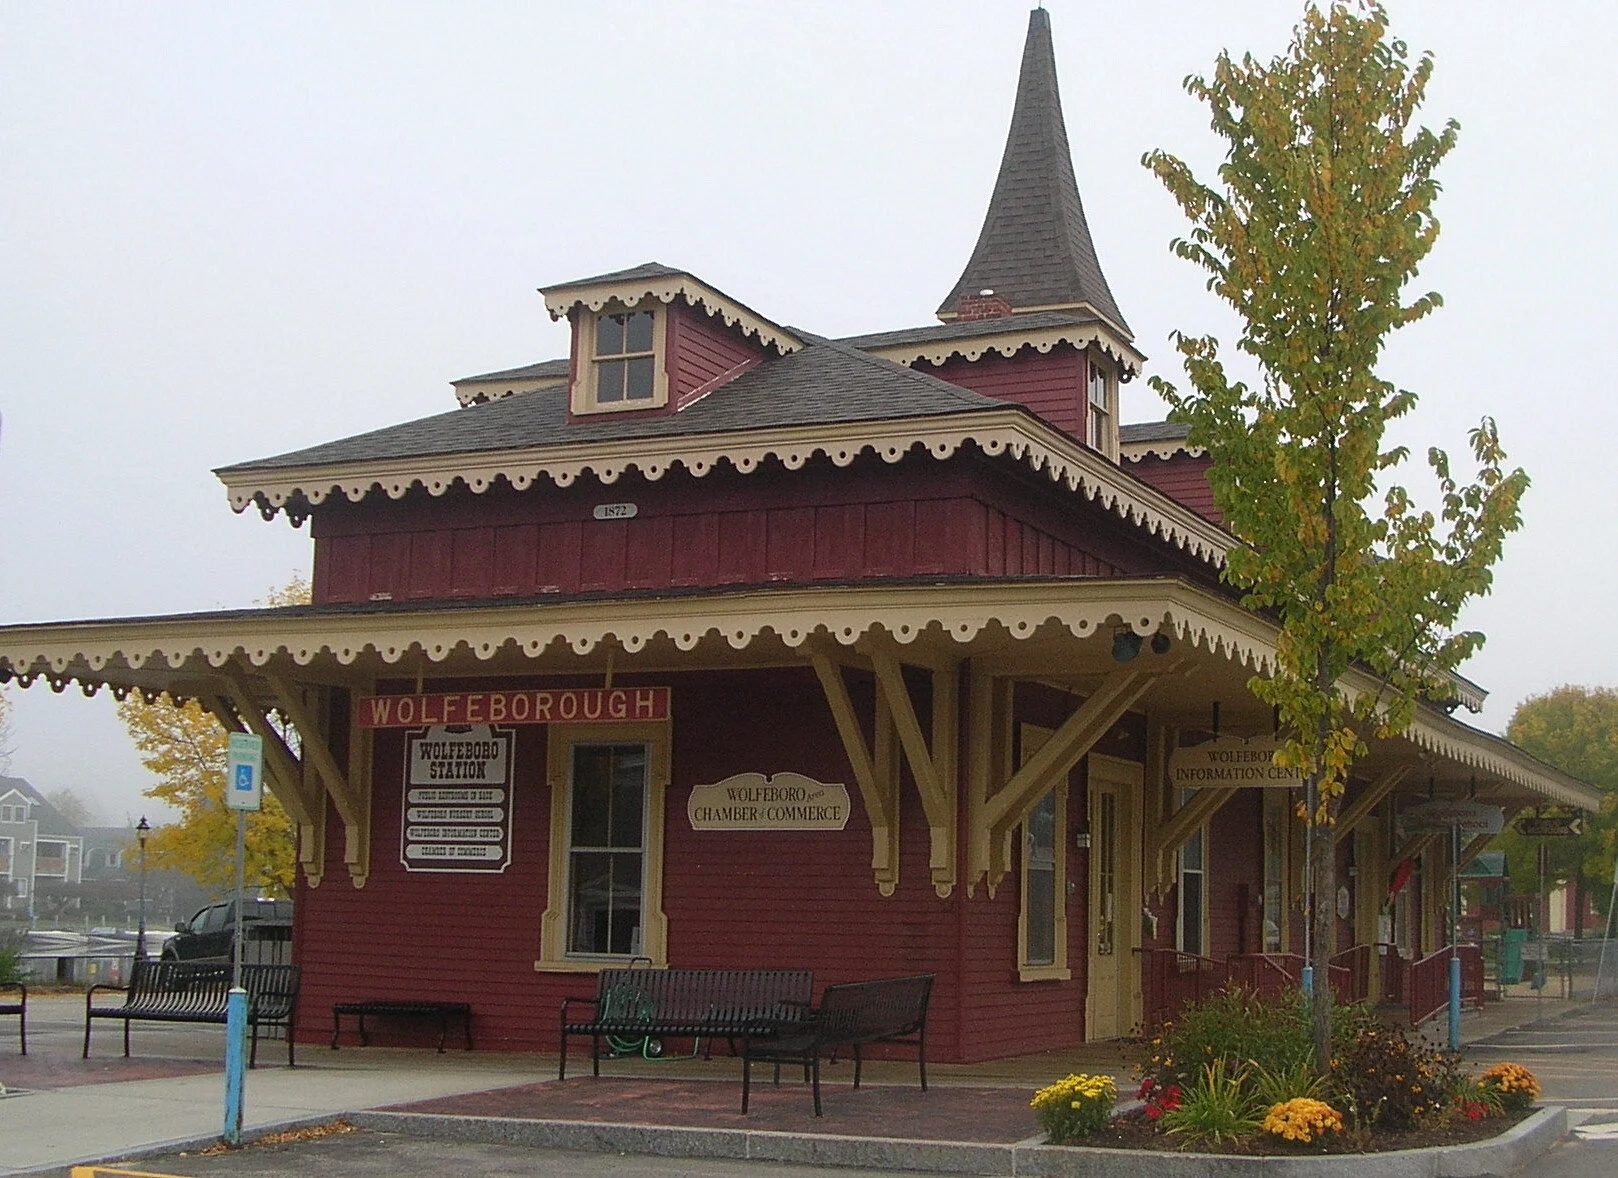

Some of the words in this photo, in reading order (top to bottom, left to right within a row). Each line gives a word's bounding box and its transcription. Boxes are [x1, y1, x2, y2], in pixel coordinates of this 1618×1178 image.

[604, 505, 627, 517] 1872
[370, 689, 654, 725] WOLFEBOROUGH
[419, 741, 499, 760] WOLFEBORO
[1207, 750, 1275, 763] WOLFEBOR
[429, 760, 487, 779] STATION
[1175, 766, 1264, 781] INFORMATION
[1267, 766, 1300, 780] CENT
[727, 787, 806, 802] WOLFEBORO
[694, 807, 758, 821] CHAMBER
[767, 806, 841, 821] COMMERCE
